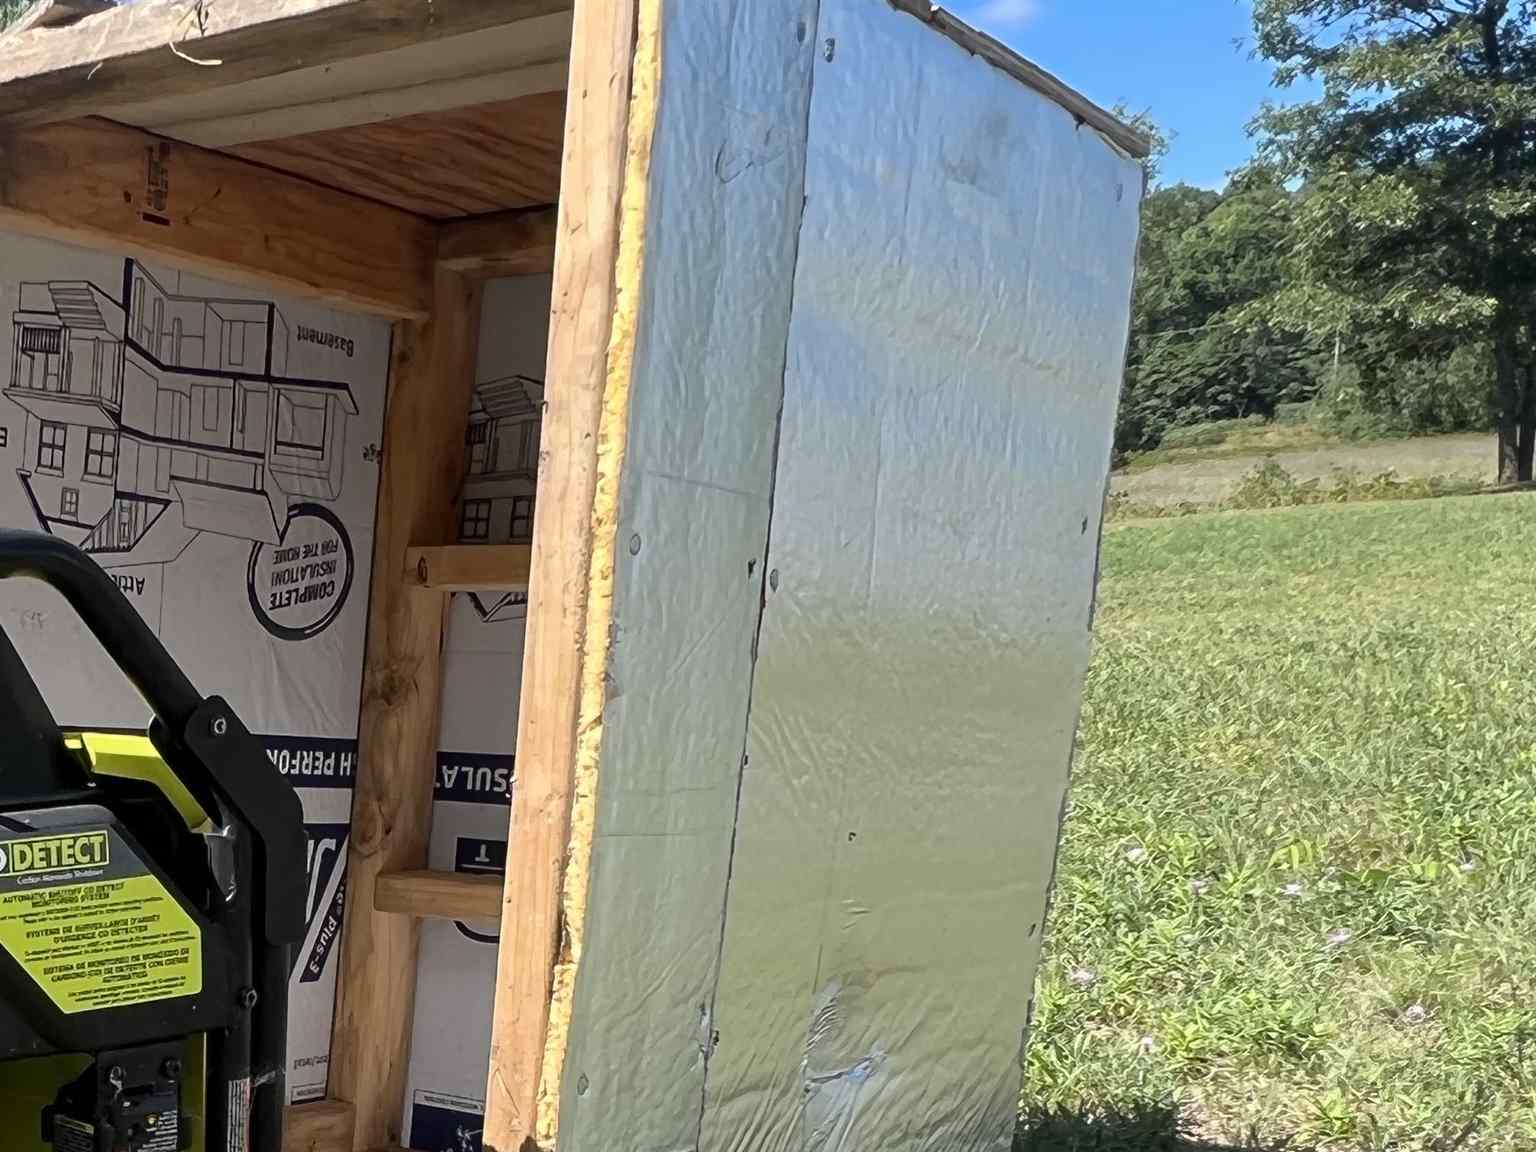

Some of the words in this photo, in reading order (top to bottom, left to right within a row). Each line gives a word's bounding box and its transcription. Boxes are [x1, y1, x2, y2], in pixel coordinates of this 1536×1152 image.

[296, 325, 354, 358] Basement
[272, 548, 301, 565] HOME
[302, 543, 319, 559] THE
[268, 580, 335, 610] COMPLETE
[434, 765, 508, 793] SULA
[13, 836, 105, 869] DETECT
